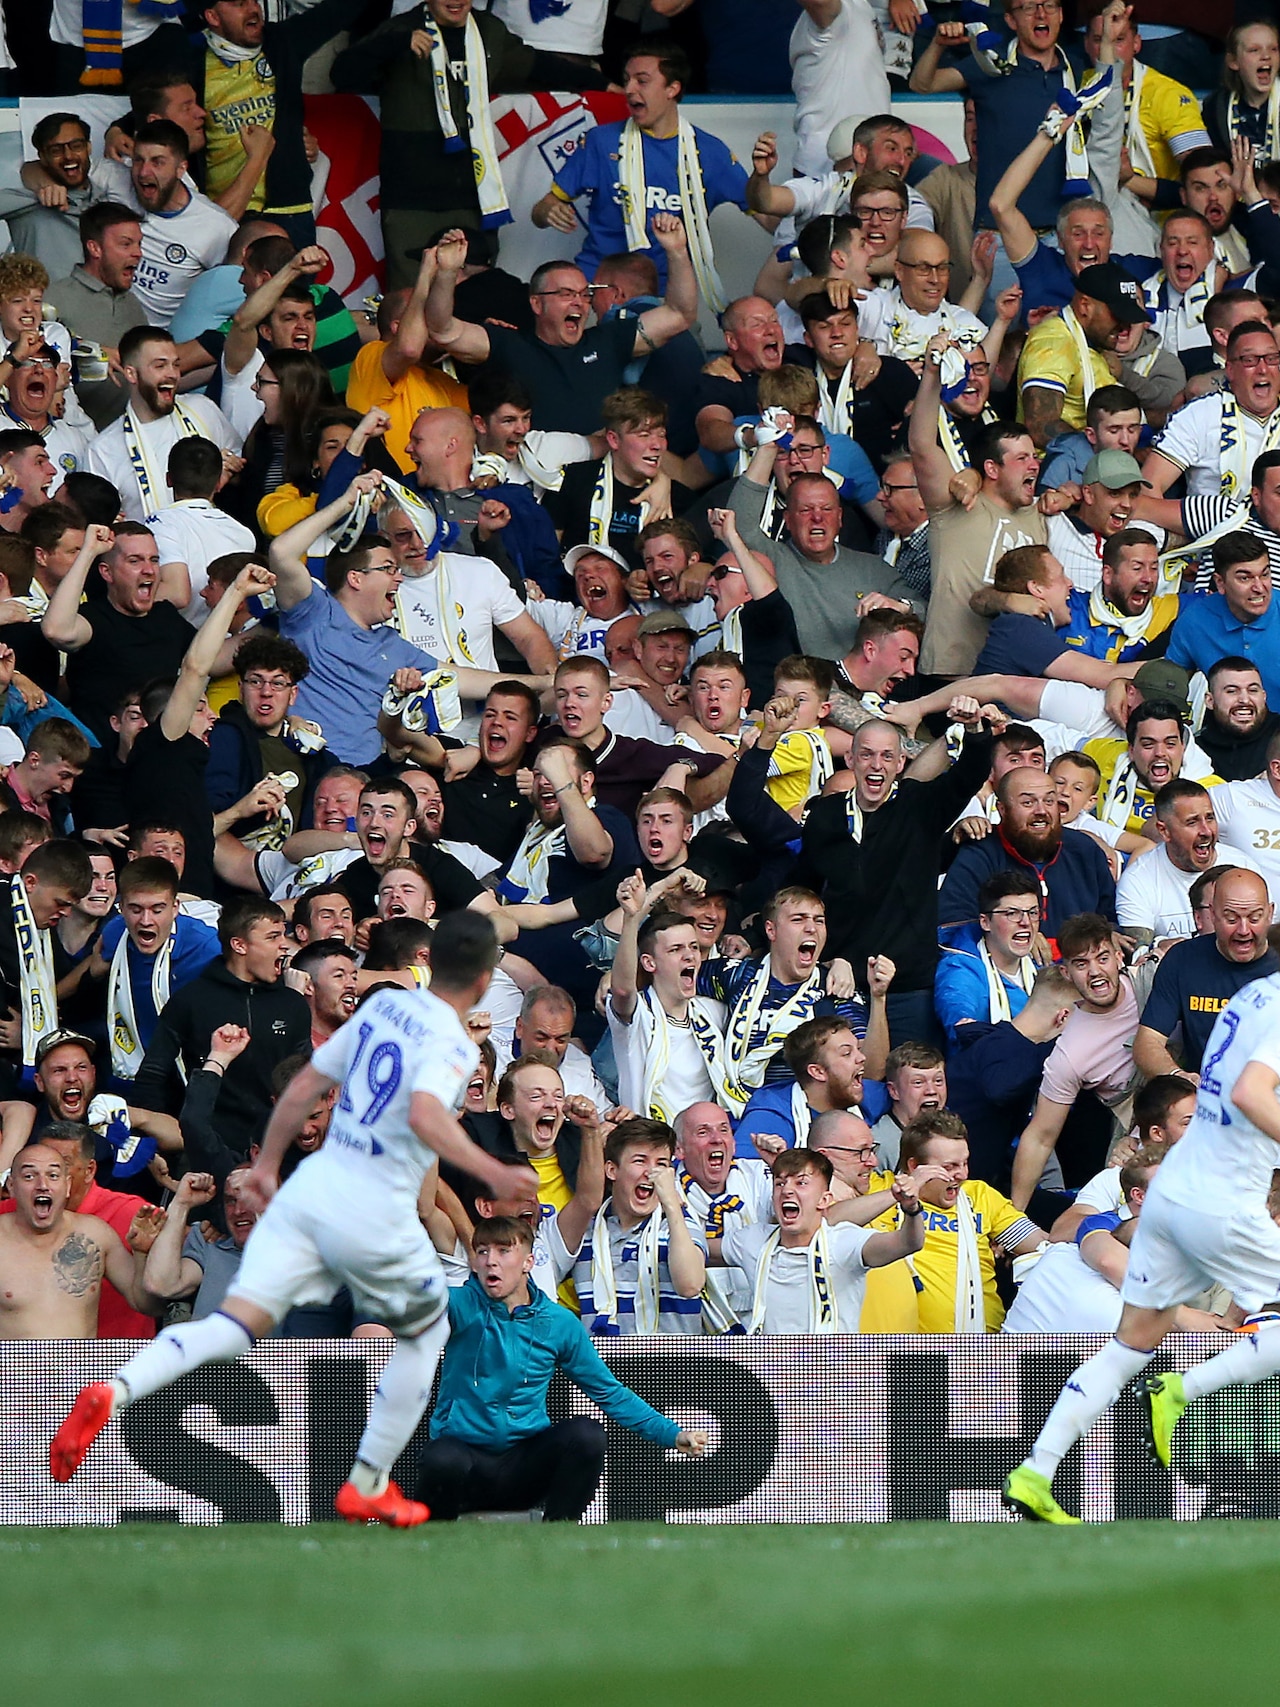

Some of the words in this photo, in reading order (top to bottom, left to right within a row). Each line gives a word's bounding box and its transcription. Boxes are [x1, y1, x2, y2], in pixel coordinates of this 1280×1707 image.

[1221, 401, 1238, 456] WE
[690, 1013, 717, 1064] WE
[339, 1021, 402, 1126] 19
